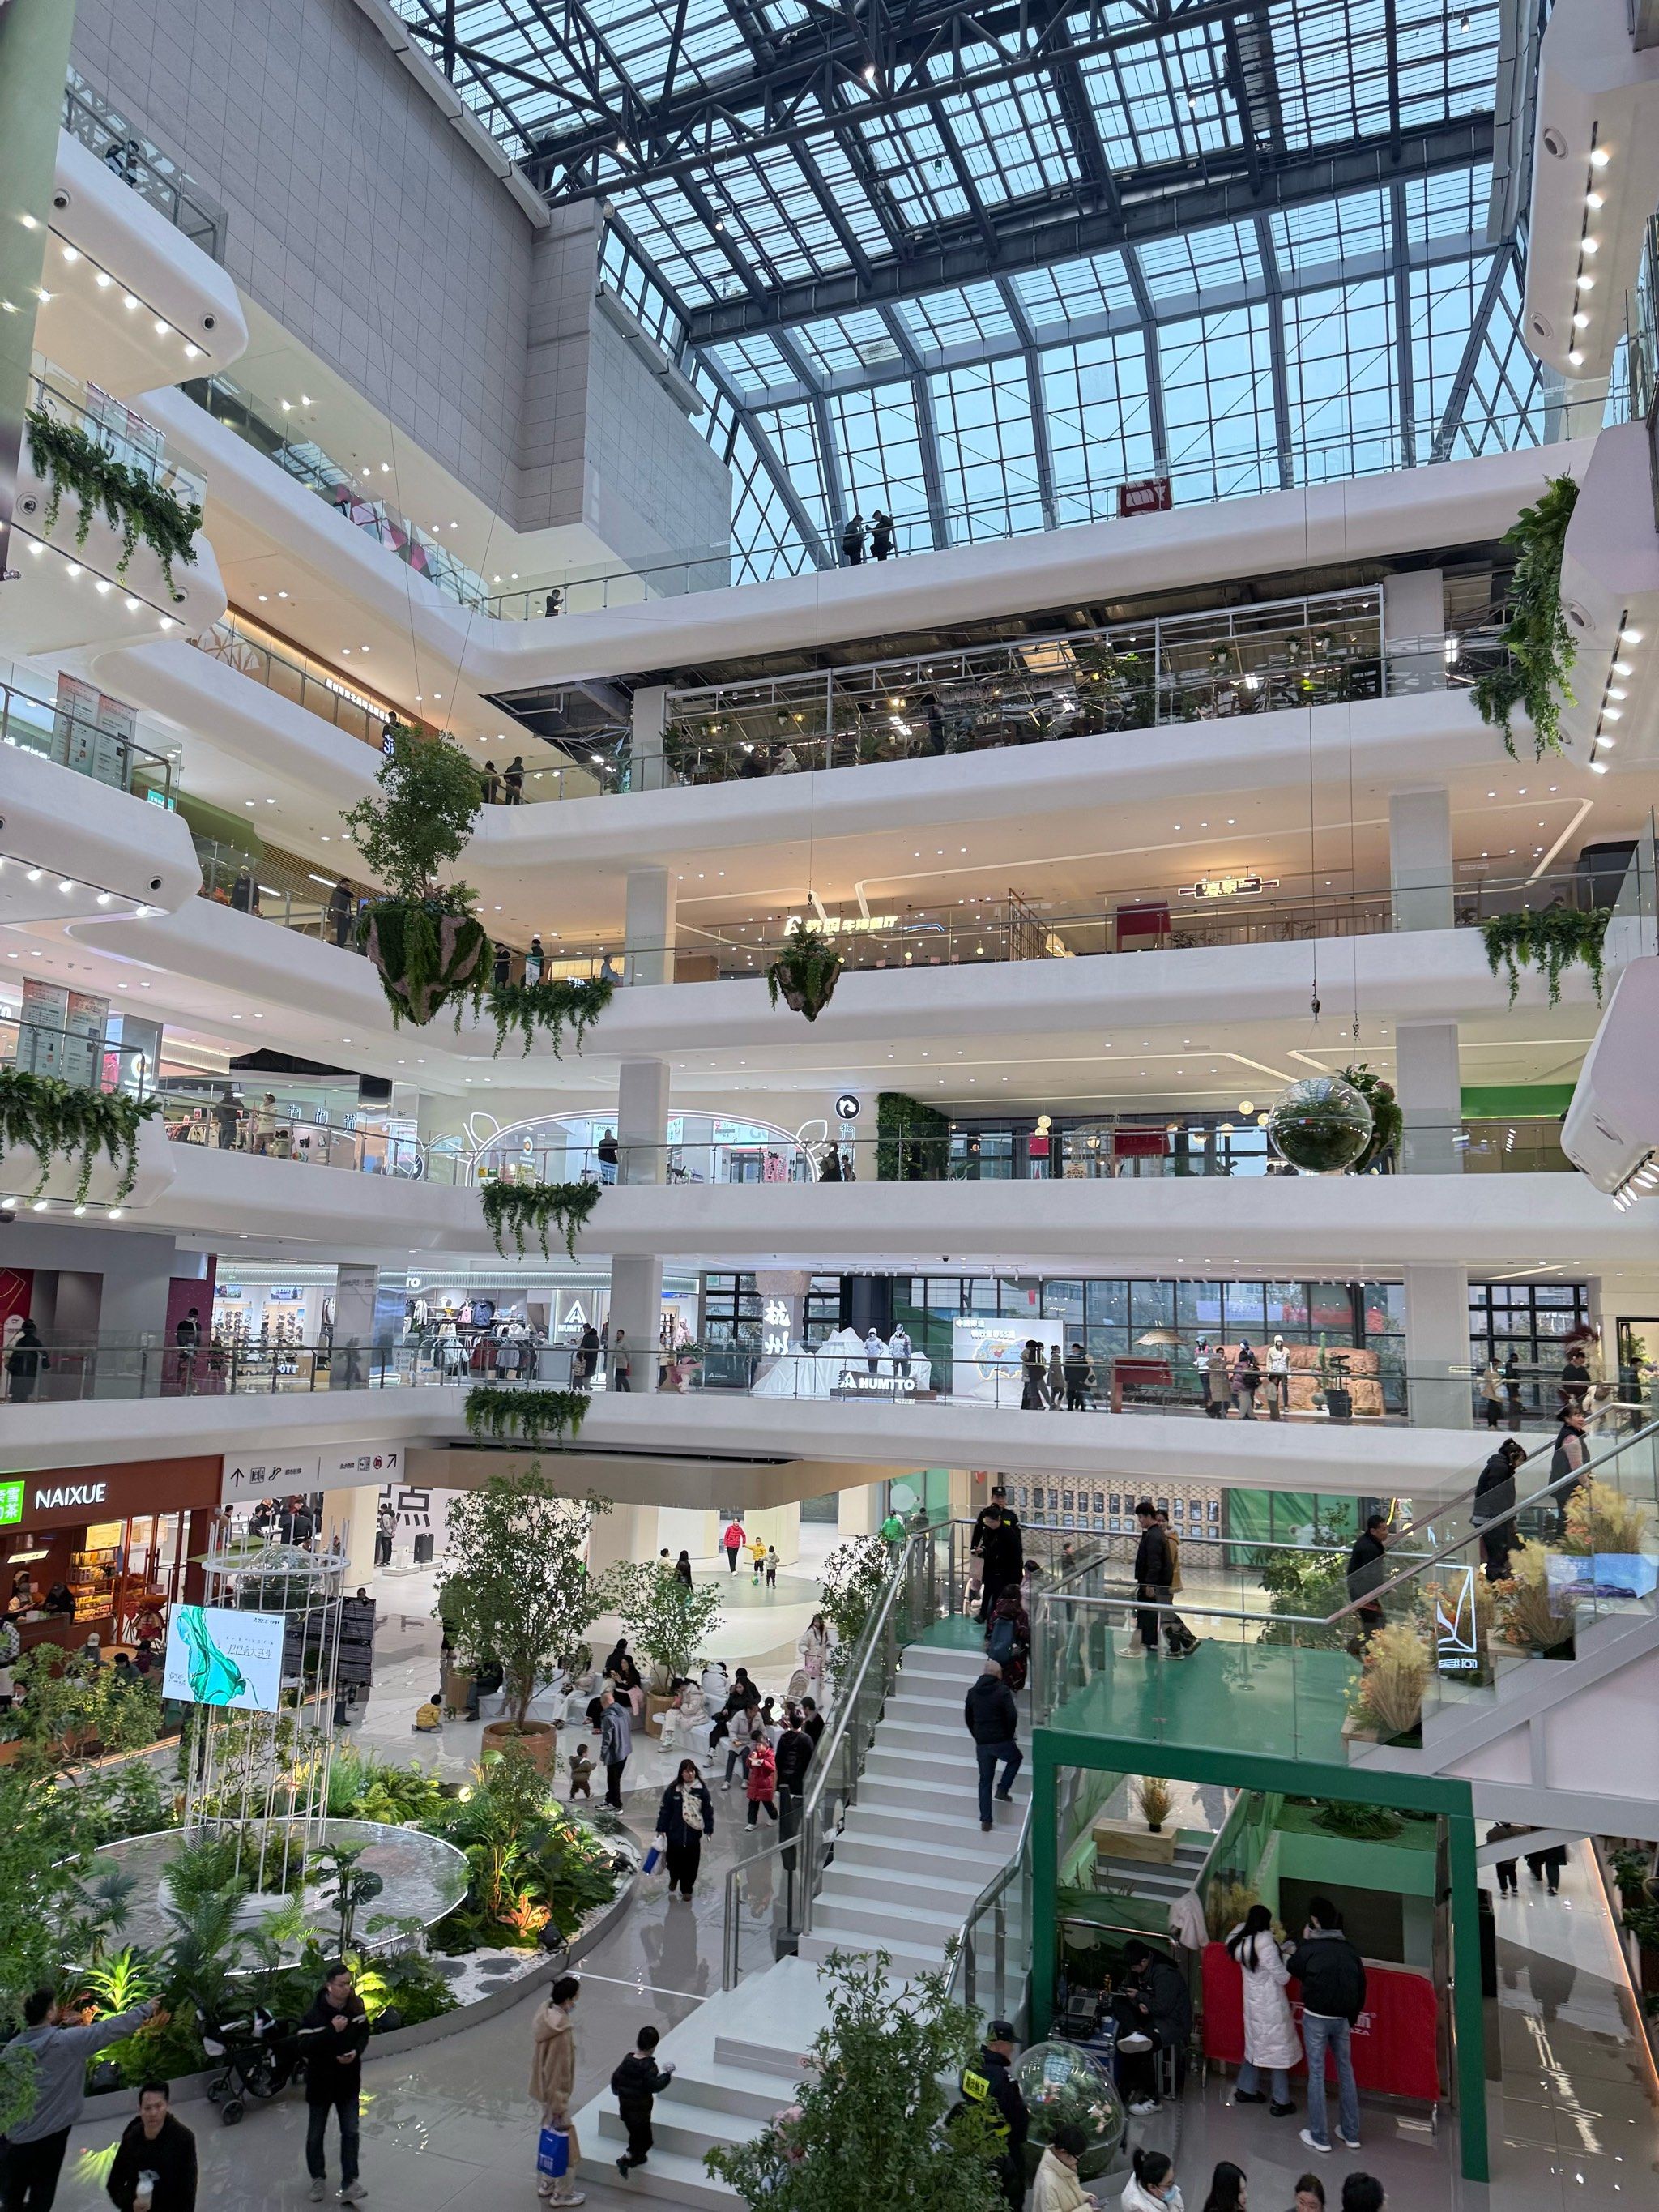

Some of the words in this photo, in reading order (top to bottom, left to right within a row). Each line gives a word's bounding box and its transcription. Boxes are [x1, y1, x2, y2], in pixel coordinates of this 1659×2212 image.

[764, 1299, 791, 1356] 杭州
[859, 1377, 915, 1390] HUMTTO
[35, 1483, 106, 1510] NAIXUE
